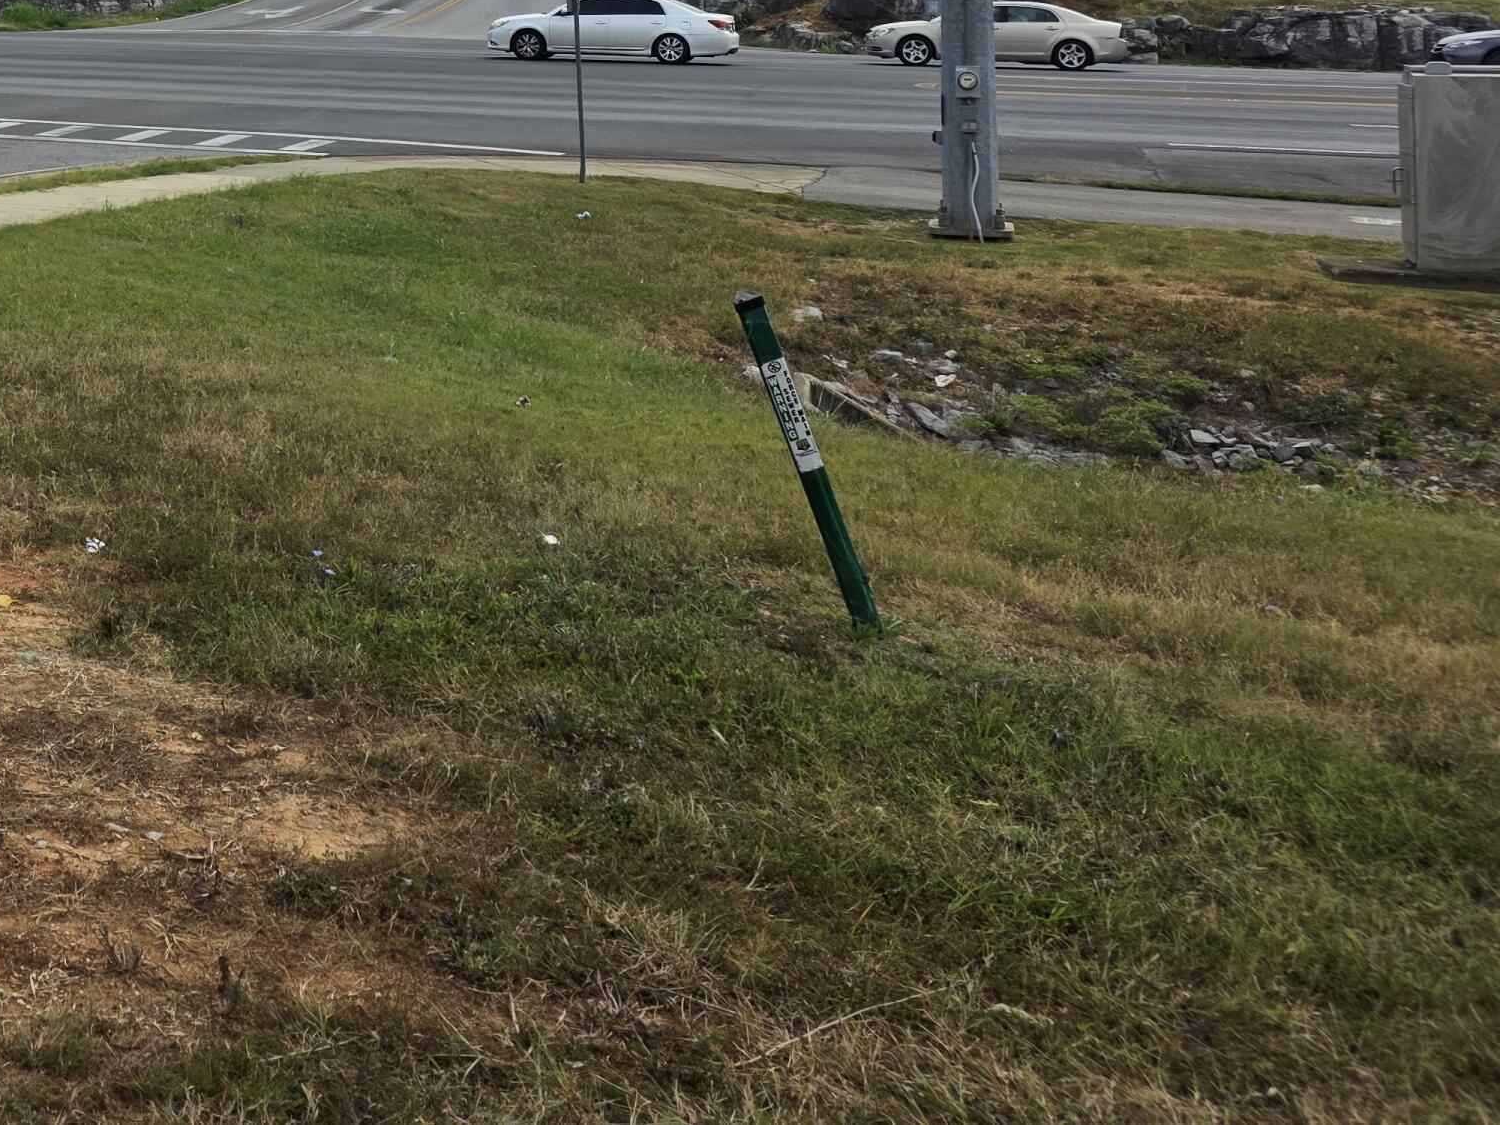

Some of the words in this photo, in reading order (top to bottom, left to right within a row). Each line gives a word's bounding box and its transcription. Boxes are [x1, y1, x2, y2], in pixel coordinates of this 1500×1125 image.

[767, 376, 798, 440] WARNING
[783, 370, 799, 405] FORCE
[798, 409, 811, 437] MAIN
[783, 388, 801, 424] SEWER
